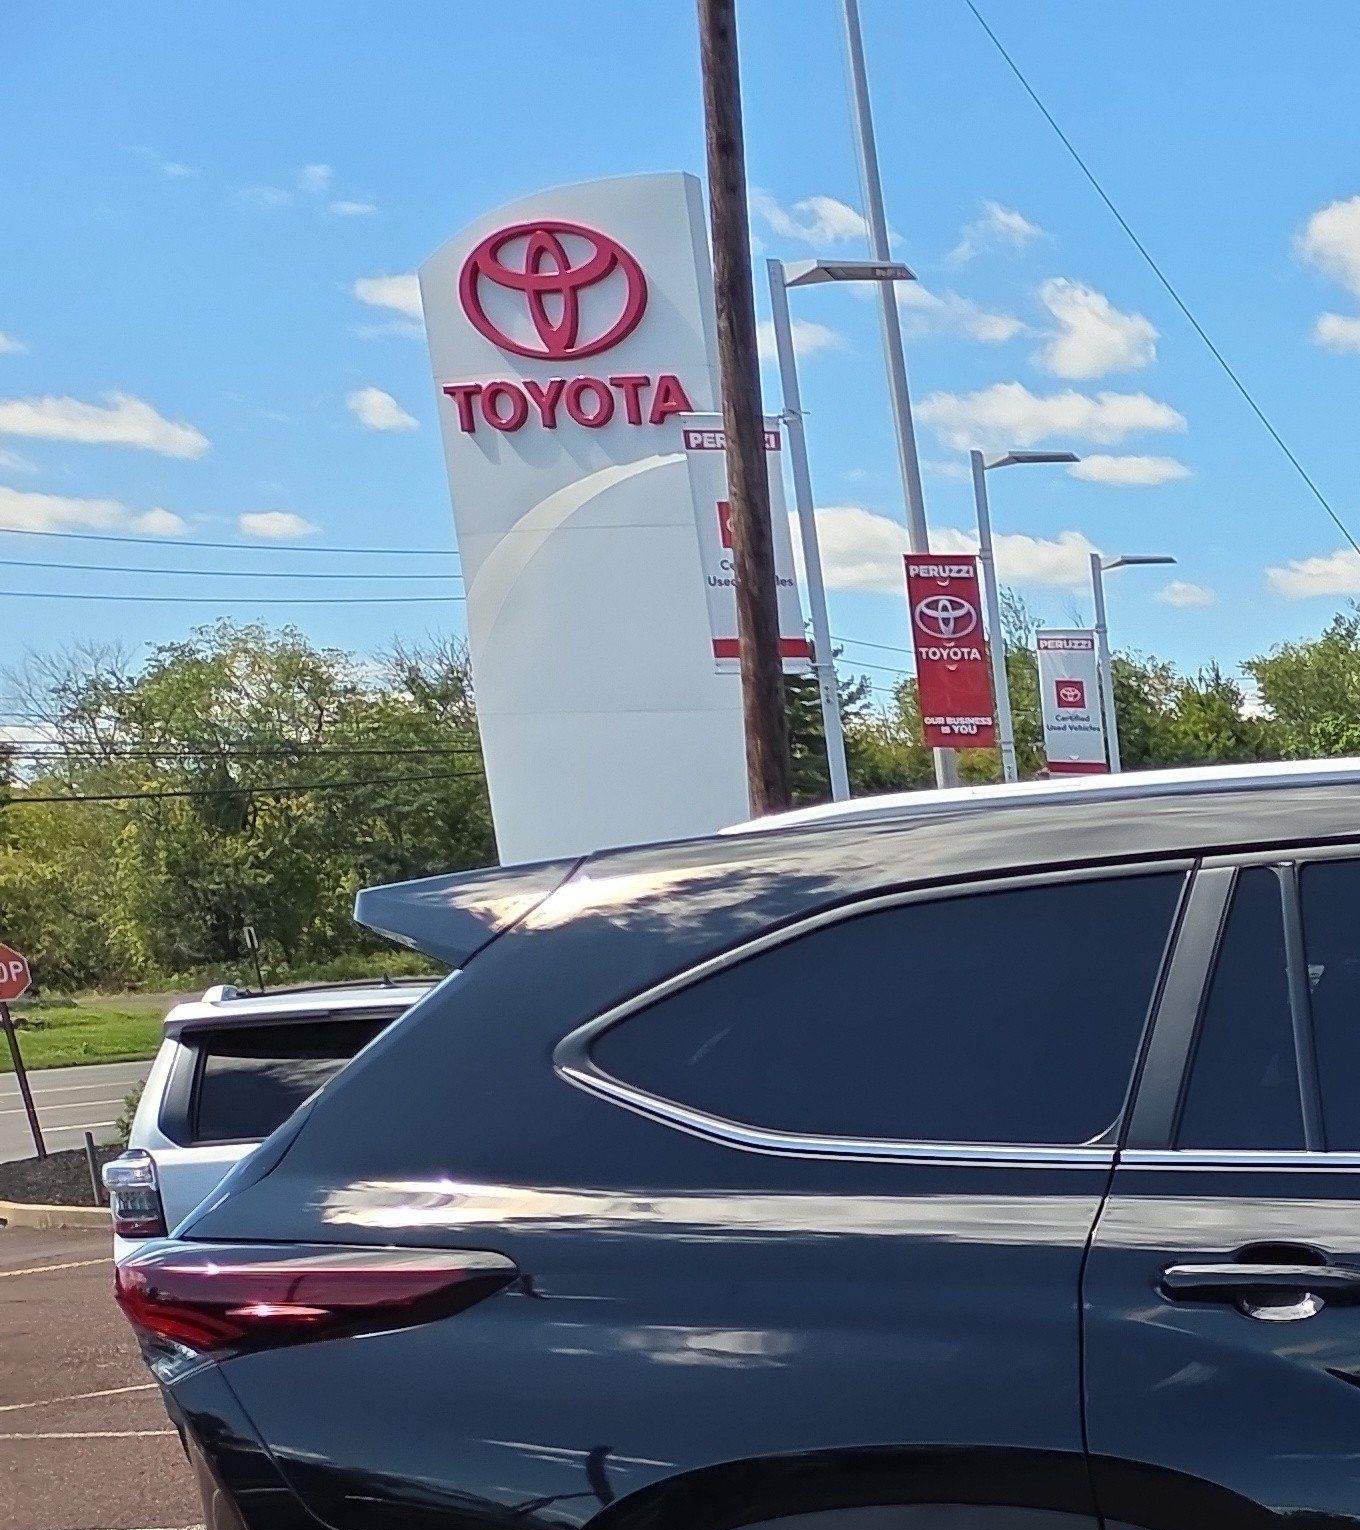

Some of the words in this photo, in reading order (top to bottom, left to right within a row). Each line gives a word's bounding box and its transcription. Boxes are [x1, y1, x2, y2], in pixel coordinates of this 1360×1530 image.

[443, 374, 692, 434] TOYOTA
[689, 432, 776, 449] PERZI
[909, 565, 974, 578] PERUZZI
[918, 648, 981, 660] TOYOTA
[951, 725, 978, 735] YOU
[0, 960, 24, 983] OP
